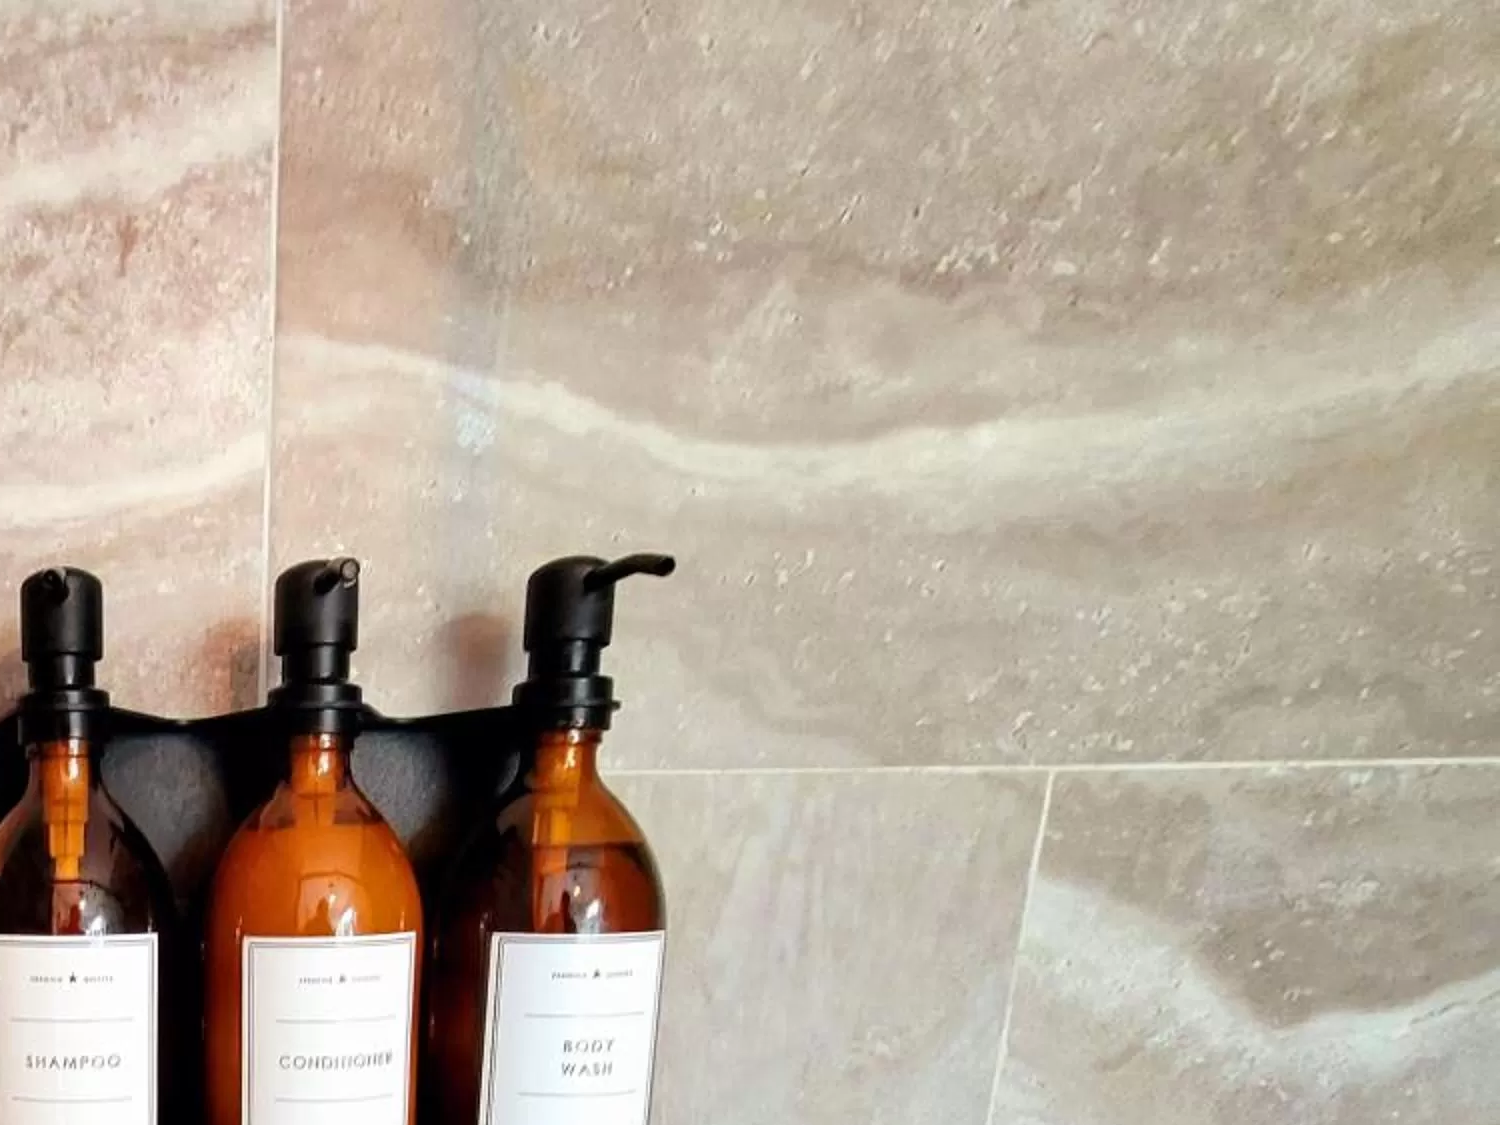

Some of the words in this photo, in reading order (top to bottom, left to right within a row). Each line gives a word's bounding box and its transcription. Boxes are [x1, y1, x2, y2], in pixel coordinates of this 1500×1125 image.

[562, 1038, 615, 1053] BODY
[25, 1054, 122, 1071] SHAMPOO
[278, 1049, 393, 1071] CONDITIONER
[561, 1061, 613, 1077] WASH
